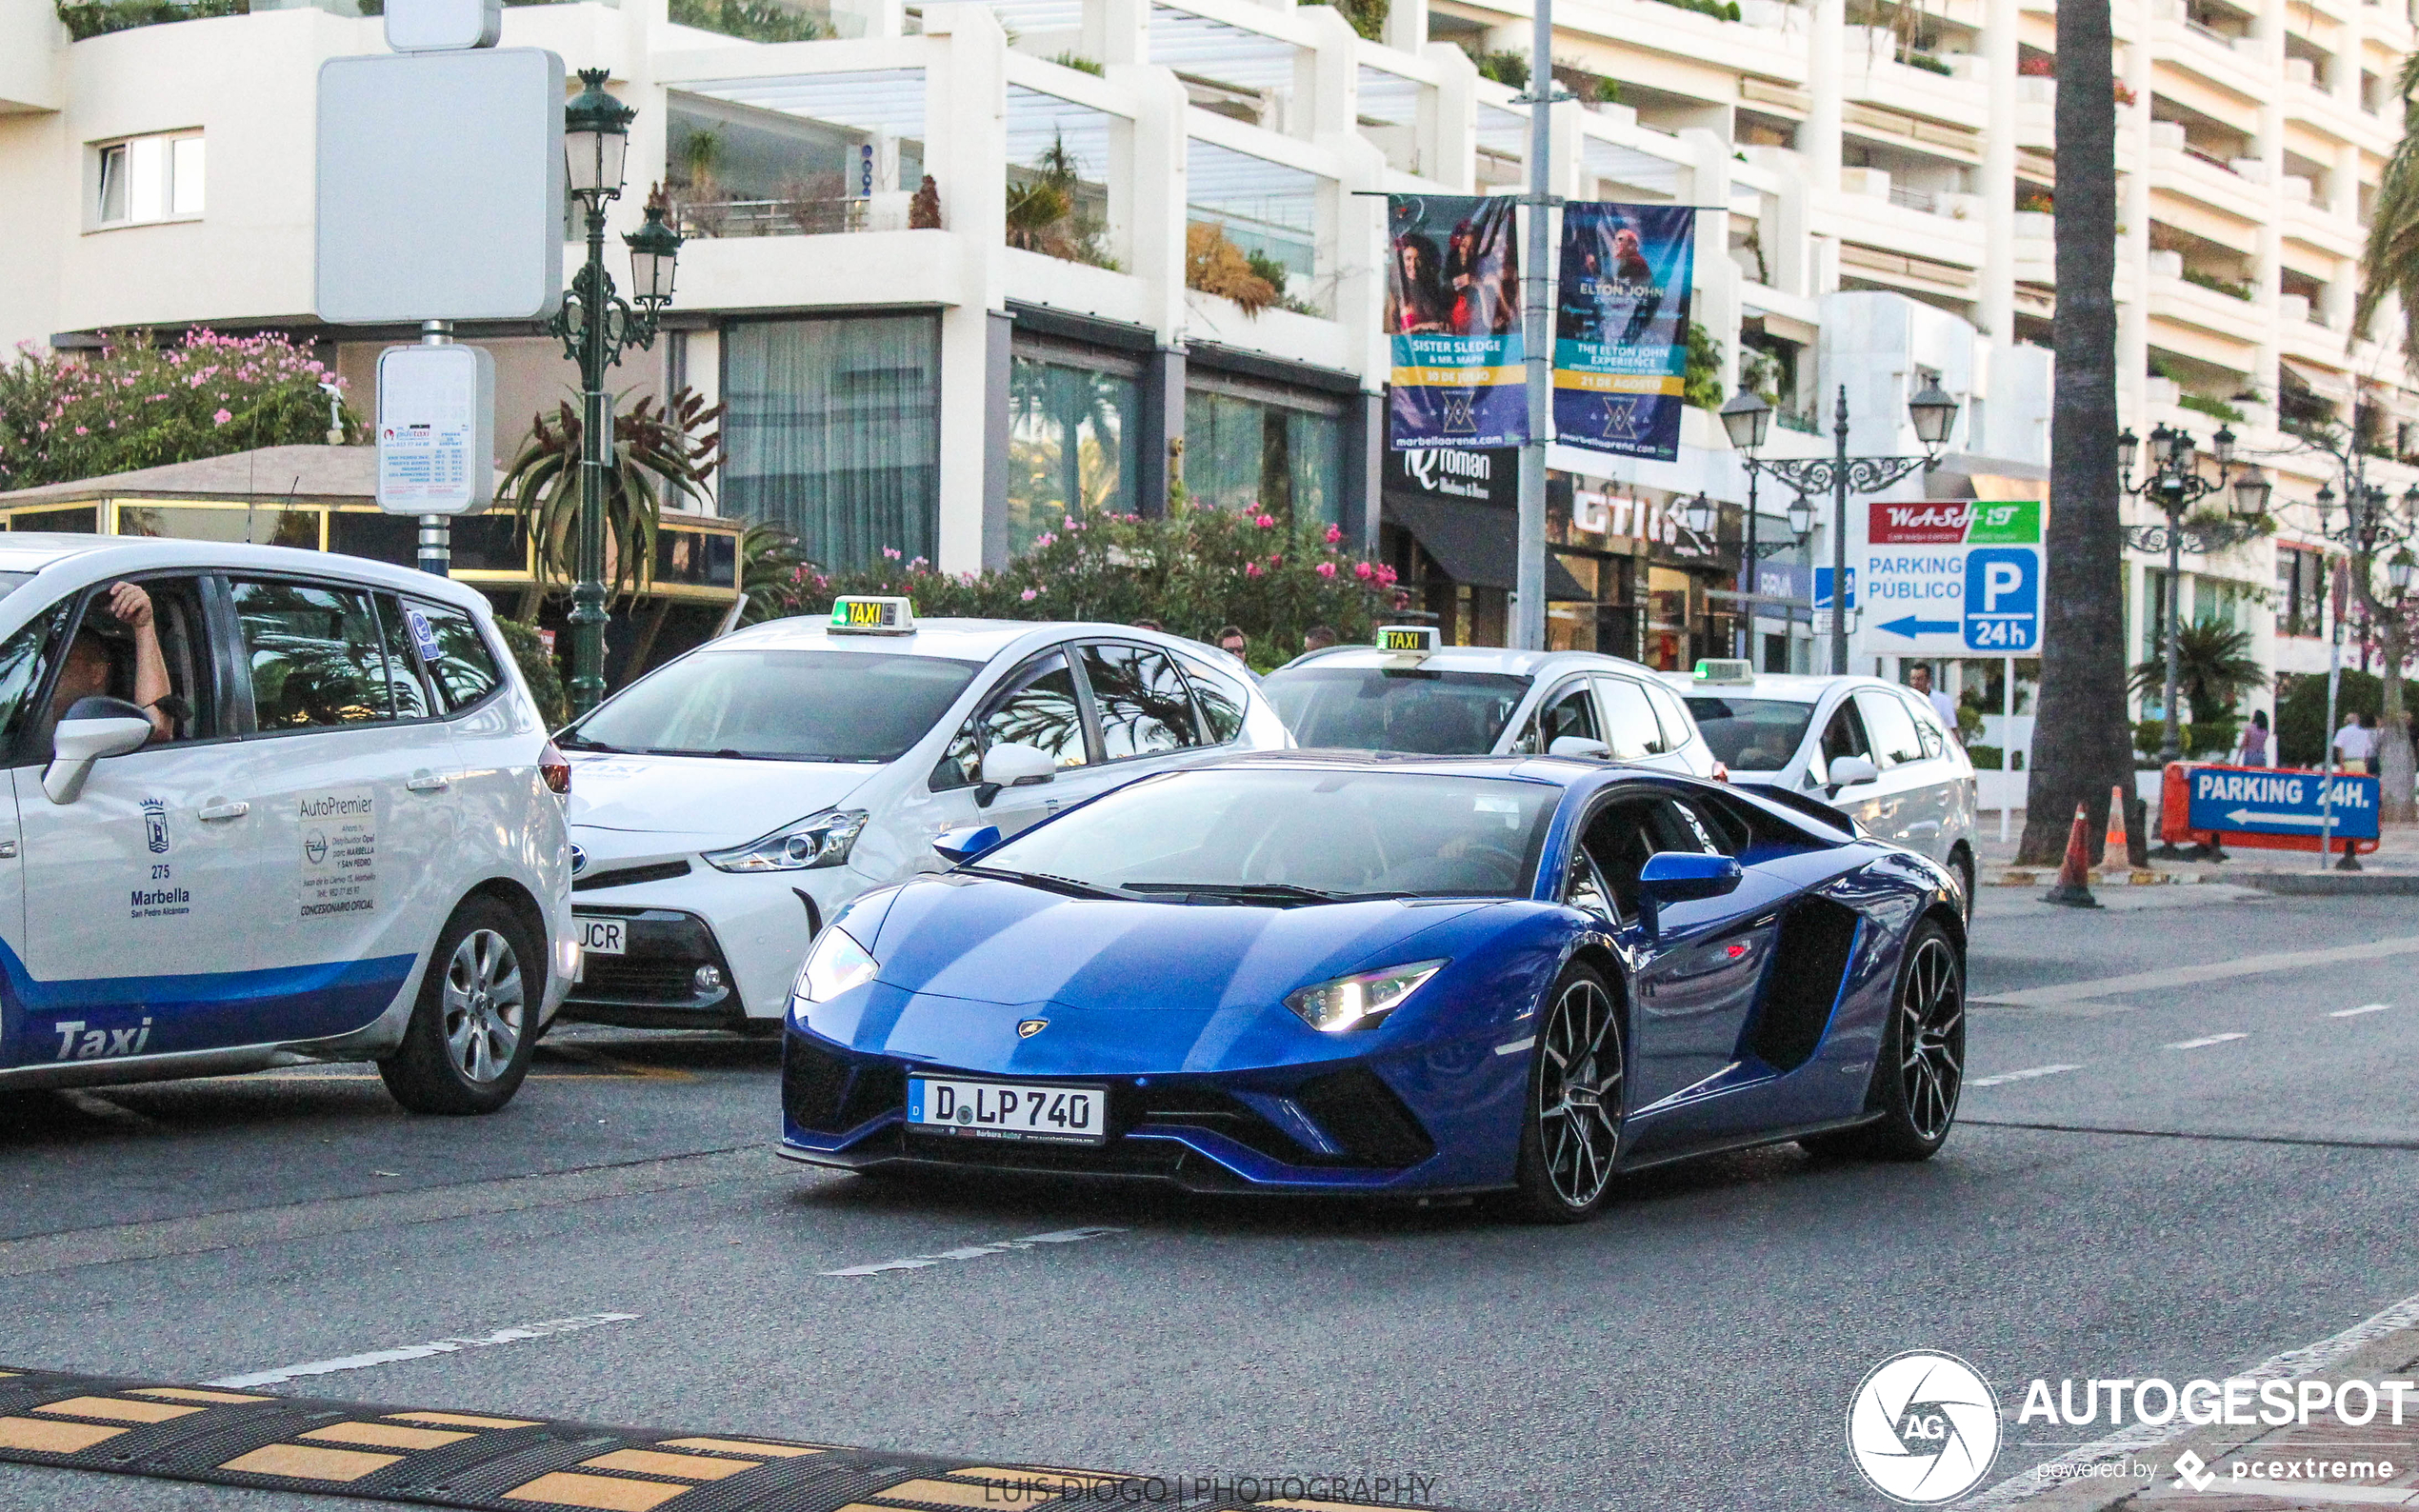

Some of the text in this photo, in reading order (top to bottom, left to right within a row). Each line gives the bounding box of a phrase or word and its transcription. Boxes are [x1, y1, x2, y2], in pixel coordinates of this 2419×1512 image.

[1579, 283, 1665, 298] ELTON JOHN
[1413, 339, 1501, 353] SISTER SLEDGE
[1577, 343, 1669, 358] THE ELTON JOHN
[1590, 356, 1656, 368] EXPERIENCE
[1441, 371, 1457, 383] DE
[1580, 376, 1663, 391] 21 DE AGOSTO
[1396, 435, 1503, 447] marbellaarena.com
[1439, 448, 1490, 481] roman
[1869, 557, 1962, 574] PARKING
[1869, 578, 1962, 599] PÚBLICO
[1984, 562, 2023, 612] P
[849, 603, 882, 624] TAXI
[1388, 631, 1419, 649] TAXI
[2197, 774, 2370, 808] PARKING 24H.
[300, 794, 372, 817] AutoPremier
[362, 833, 375, 845] Opel
[346, 846, 374, 858] MARBELLA
[341, 859, 353, 868] SAN
[353, 858, 372, 867] PEDRO
[151, 865, 170, 880] 275
[130, 887, 190, 906] Marbella
[130, 909, 144, 919] San
[144, 907, 161, 918] Pedro
[300, 899, 373, 916] CONCESIONARIO OFICIAL
[55, 1016, 152, 1060] Taxi
[911, 1106, 920, 1116] D
[936, 1085, 1090, 1129] D LP 740
